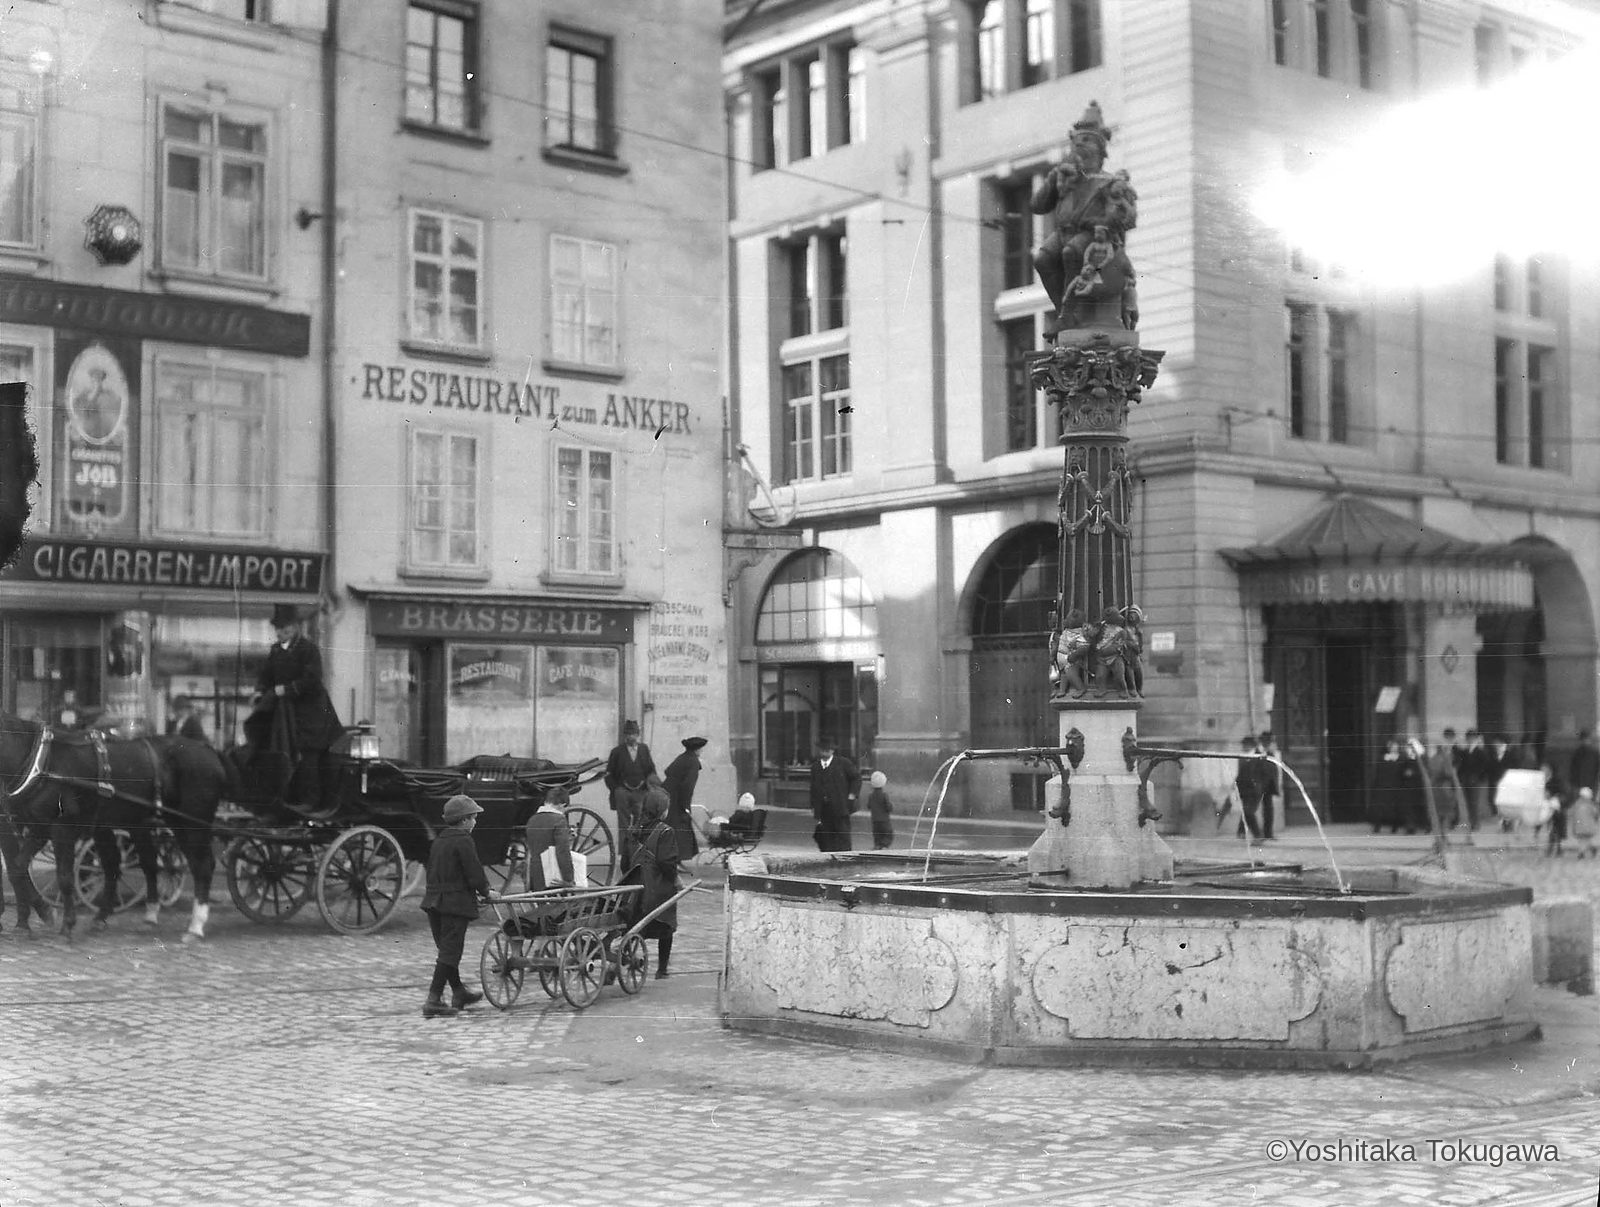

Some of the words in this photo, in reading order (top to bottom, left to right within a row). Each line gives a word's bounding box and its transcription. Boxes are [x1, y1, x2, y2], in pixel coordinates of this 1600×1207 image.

[362, 363, 560, 420] RESTAURANT
[562, 403, 598, 425] zum
[601, 393, 693, 435] ANKER
[1348, 572, 1404, 594] CAVE
[400, 605, 603, 635] BRASSERIE
[460, 661, 522, 683] RESTAURANT
